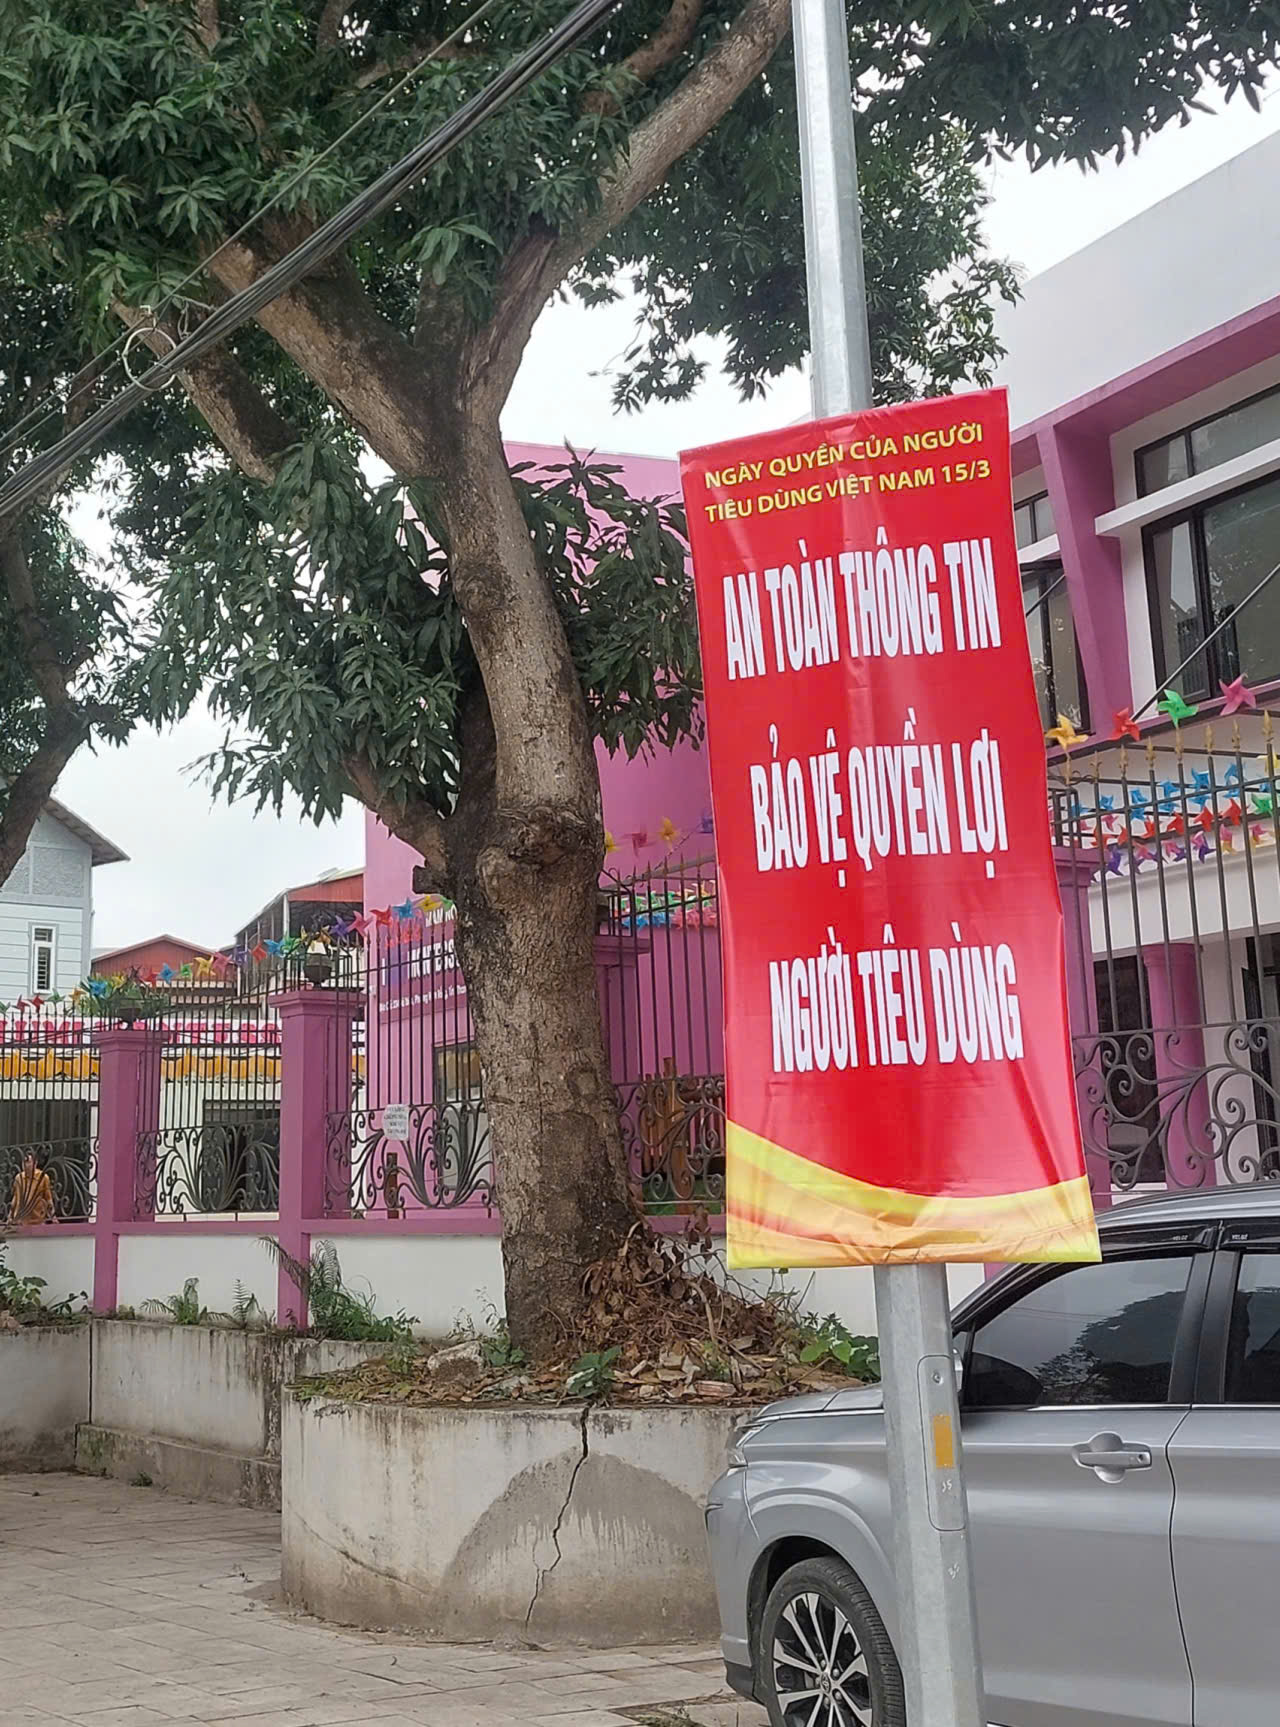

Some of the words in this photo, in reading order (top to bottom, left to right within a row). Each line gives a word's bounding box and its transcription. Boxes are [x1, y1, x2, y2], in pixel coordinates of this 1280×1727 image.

[705, 461, 763, 489] NGÀY
[770, 443, 844, 477] QUYỀN
[850, 435, 898, 460] CỦA
[904, 422, 983, 453] NGƯỜI
[705, 497, 753, 523] TIÊU
[758, 485, 823, 514] DÙNG
[826, 474, 873, 499] VIỆT
[880, 467, 935, 492] NAM
[942, 459, 991, 483] 15/3
[723, 572, 766, 680] AN
[765, 539, 840, 672] TOÀN
[839, 526, 943, 658] THÔNG
[943, 537, 1001, 651] TIN
[749, 723, 808, 872] BẢO
[809, 728, 847, 887] VỆ
[848, 707, 951, 872] QUYỀN
[952, 728, 1008, 879] LỢI
[769, 926, 858, 1073] NGƯỜI
[857, 923, 927, 1066] TIÊU
[929, 921, 1024, 1064] DÙNG
